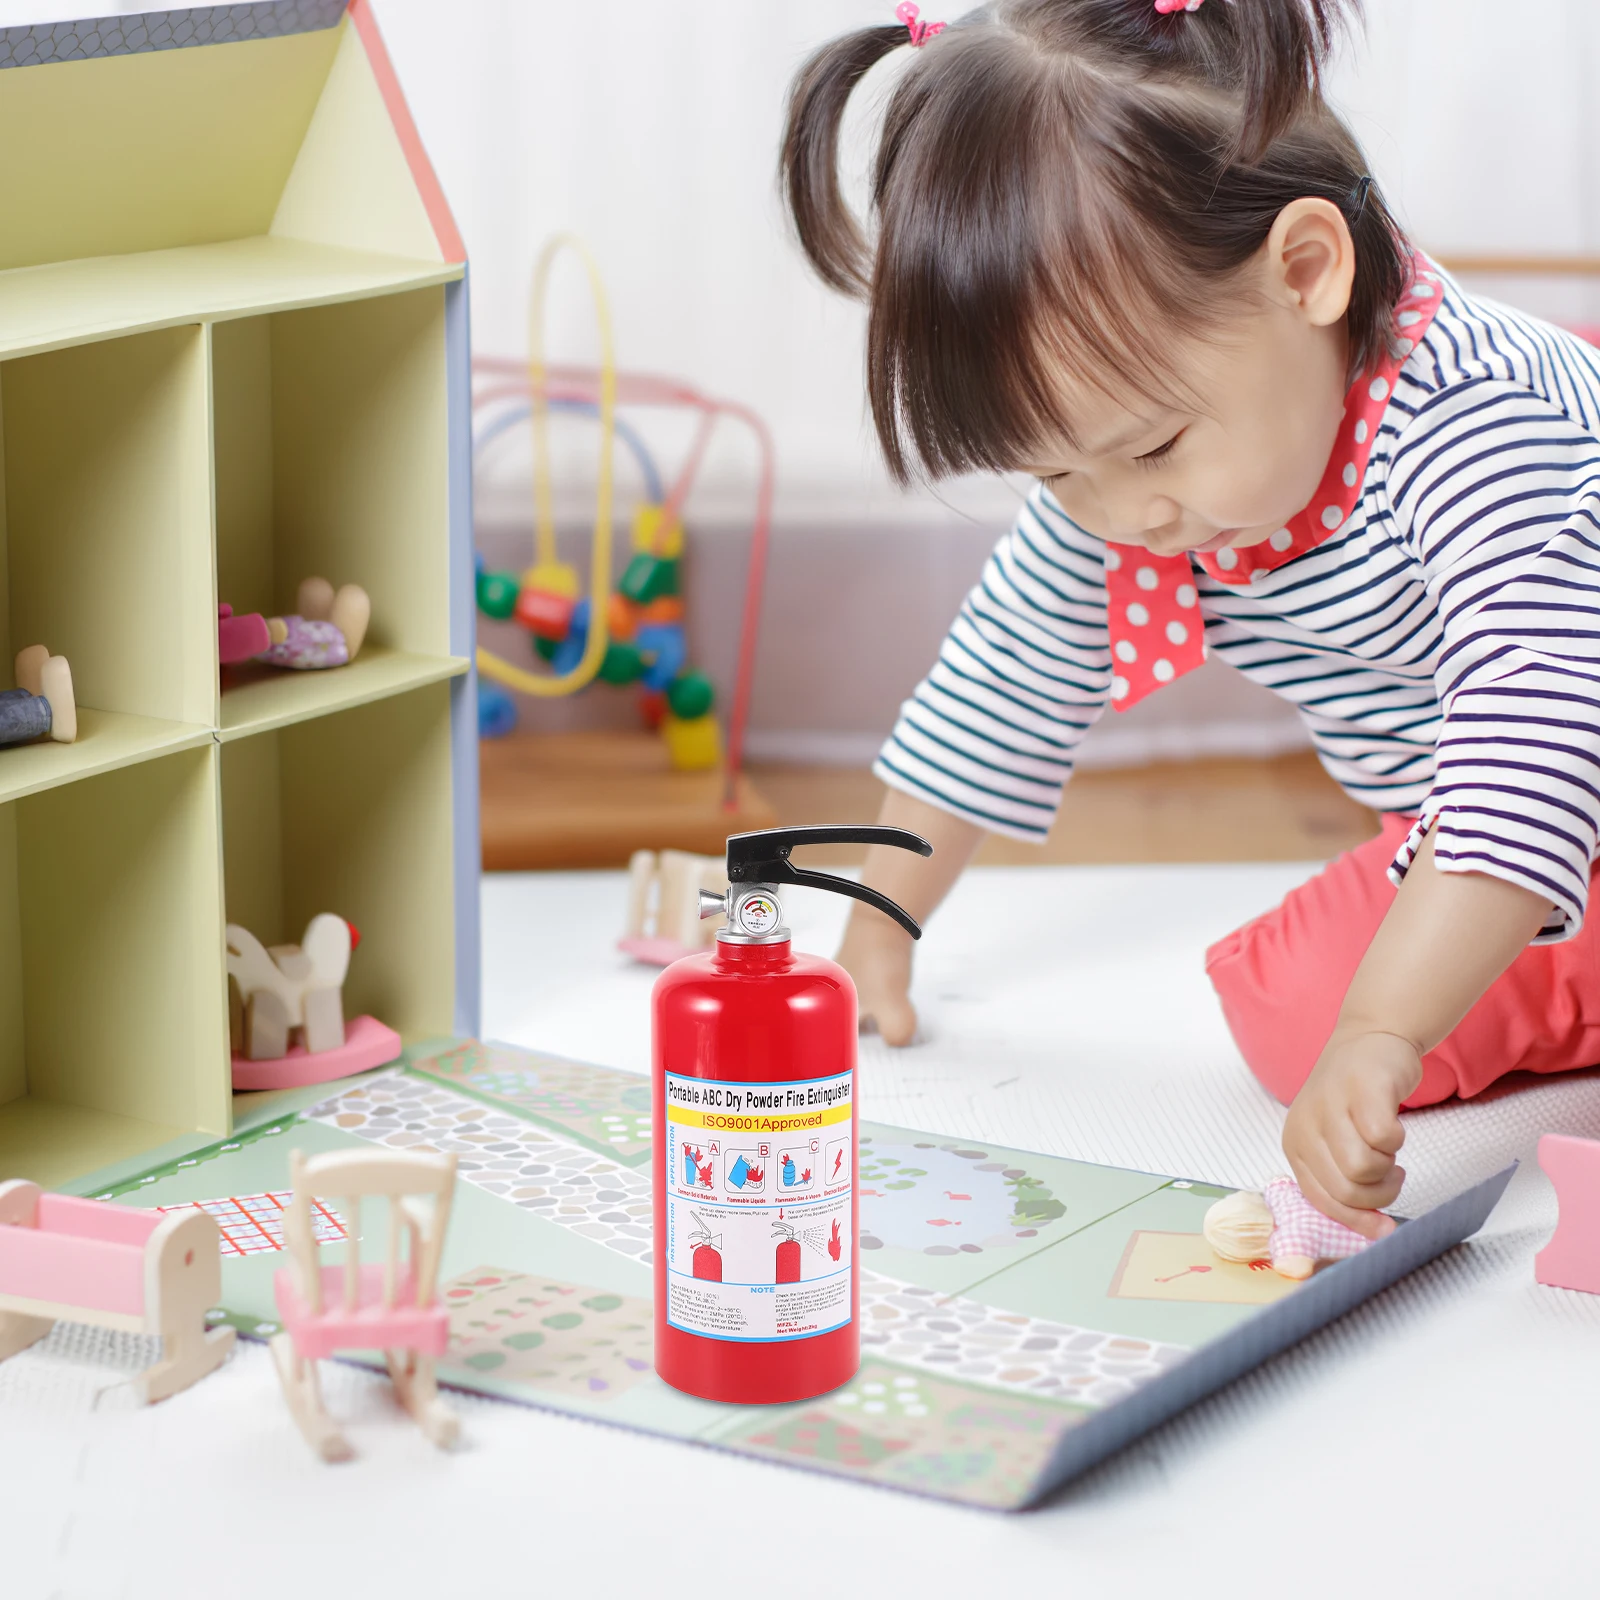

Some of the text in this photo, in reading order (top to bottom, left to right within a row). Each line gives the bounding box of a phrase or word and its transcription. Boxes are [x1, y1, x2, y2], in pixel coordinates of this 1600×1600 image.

[668, 1081, 850, 1112] Portable ABC Dry Powder Fire Extinguisher
[709, 1144, 718, 1154] A
[760, 1145, 768, 1156] B
[810, 1140, 818, 1151] C
